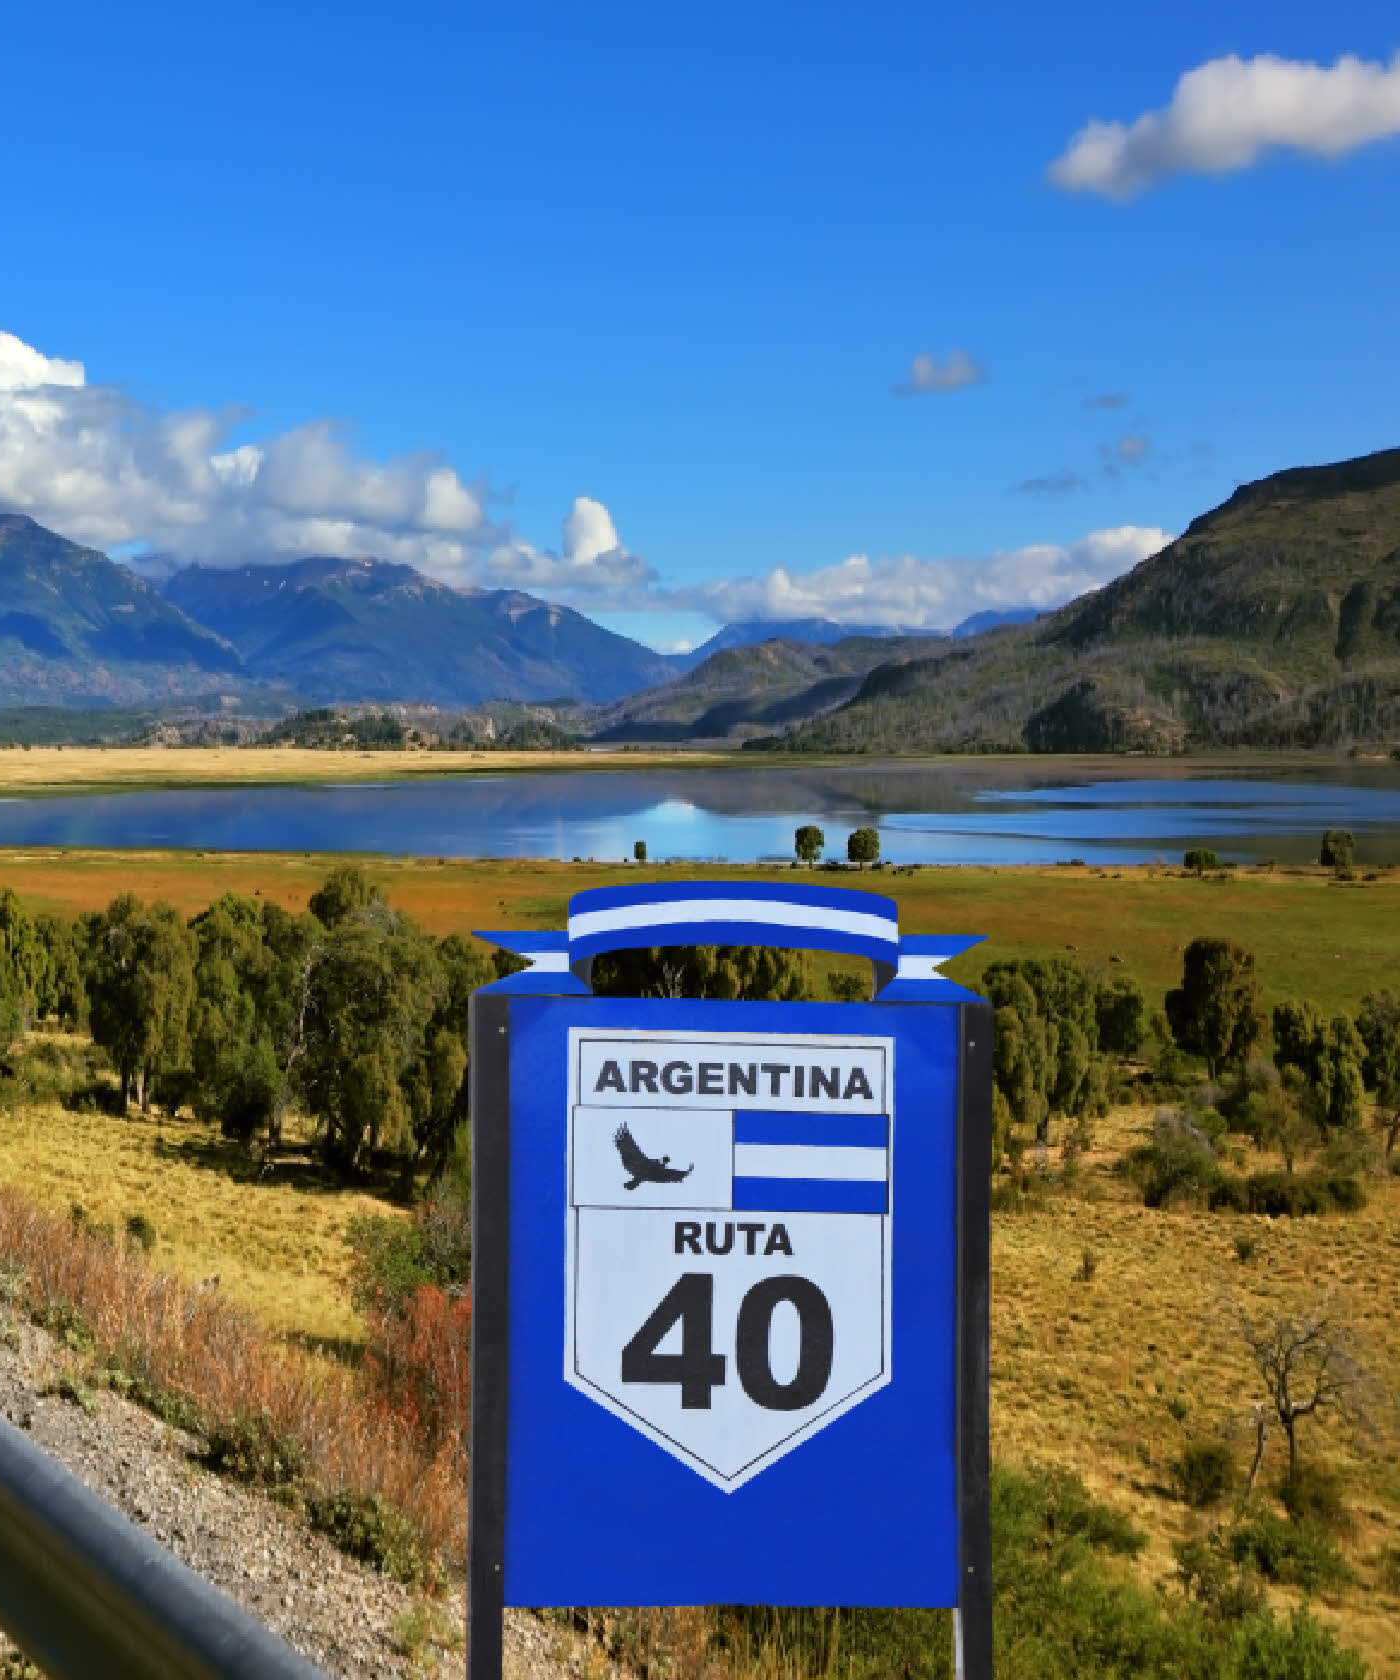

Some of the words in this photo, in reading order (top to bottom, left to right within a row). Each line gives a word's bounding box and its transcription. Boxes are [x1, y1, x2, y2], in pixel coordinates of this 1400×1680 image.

[595, 1060, 873, 1100] ARGENTINA
[673, 1221, 793, 1256] RUTA
[621, 1273, 834, 1412] 40
